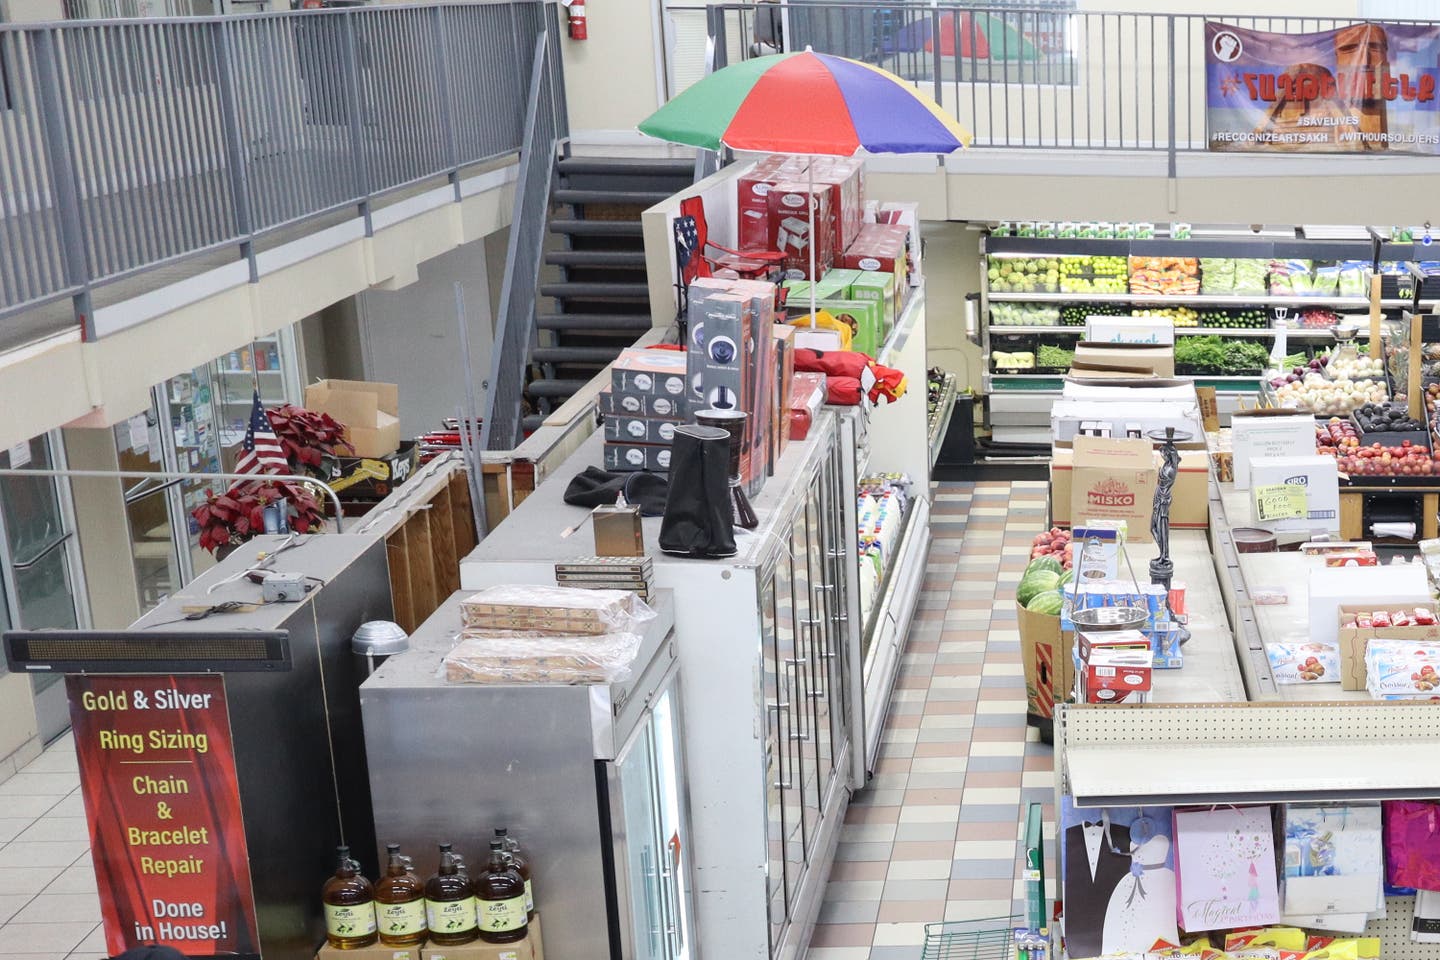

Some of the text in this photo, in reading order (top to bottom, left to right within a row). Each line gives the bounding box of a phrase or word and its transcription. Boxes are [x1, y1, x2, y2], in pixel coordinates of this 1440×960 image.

[1296, 116, 1360, 127] #SAVELIVES
[1212, 132, 1328, 143] #RECOGNIZEARTSAKH
[1339, 132, 1440, 145] #WITHOURSOLDIERS
[391, 458, 410, 482] Keys
[1089, 494, 1133, 505] MISKO
[82, 689, 211, 711] Gold & Silver
[100, 730, 208, 753] Ring Sizing
[132, 775, 188, 794] Chain
[157, 801, 172, 820] &
[128, 826, 208, 846] Bracelet
[141, 856, 204, 878] Repair
[152, 899, 204, 918] Done
[135, 921, 227, 941] in House!
